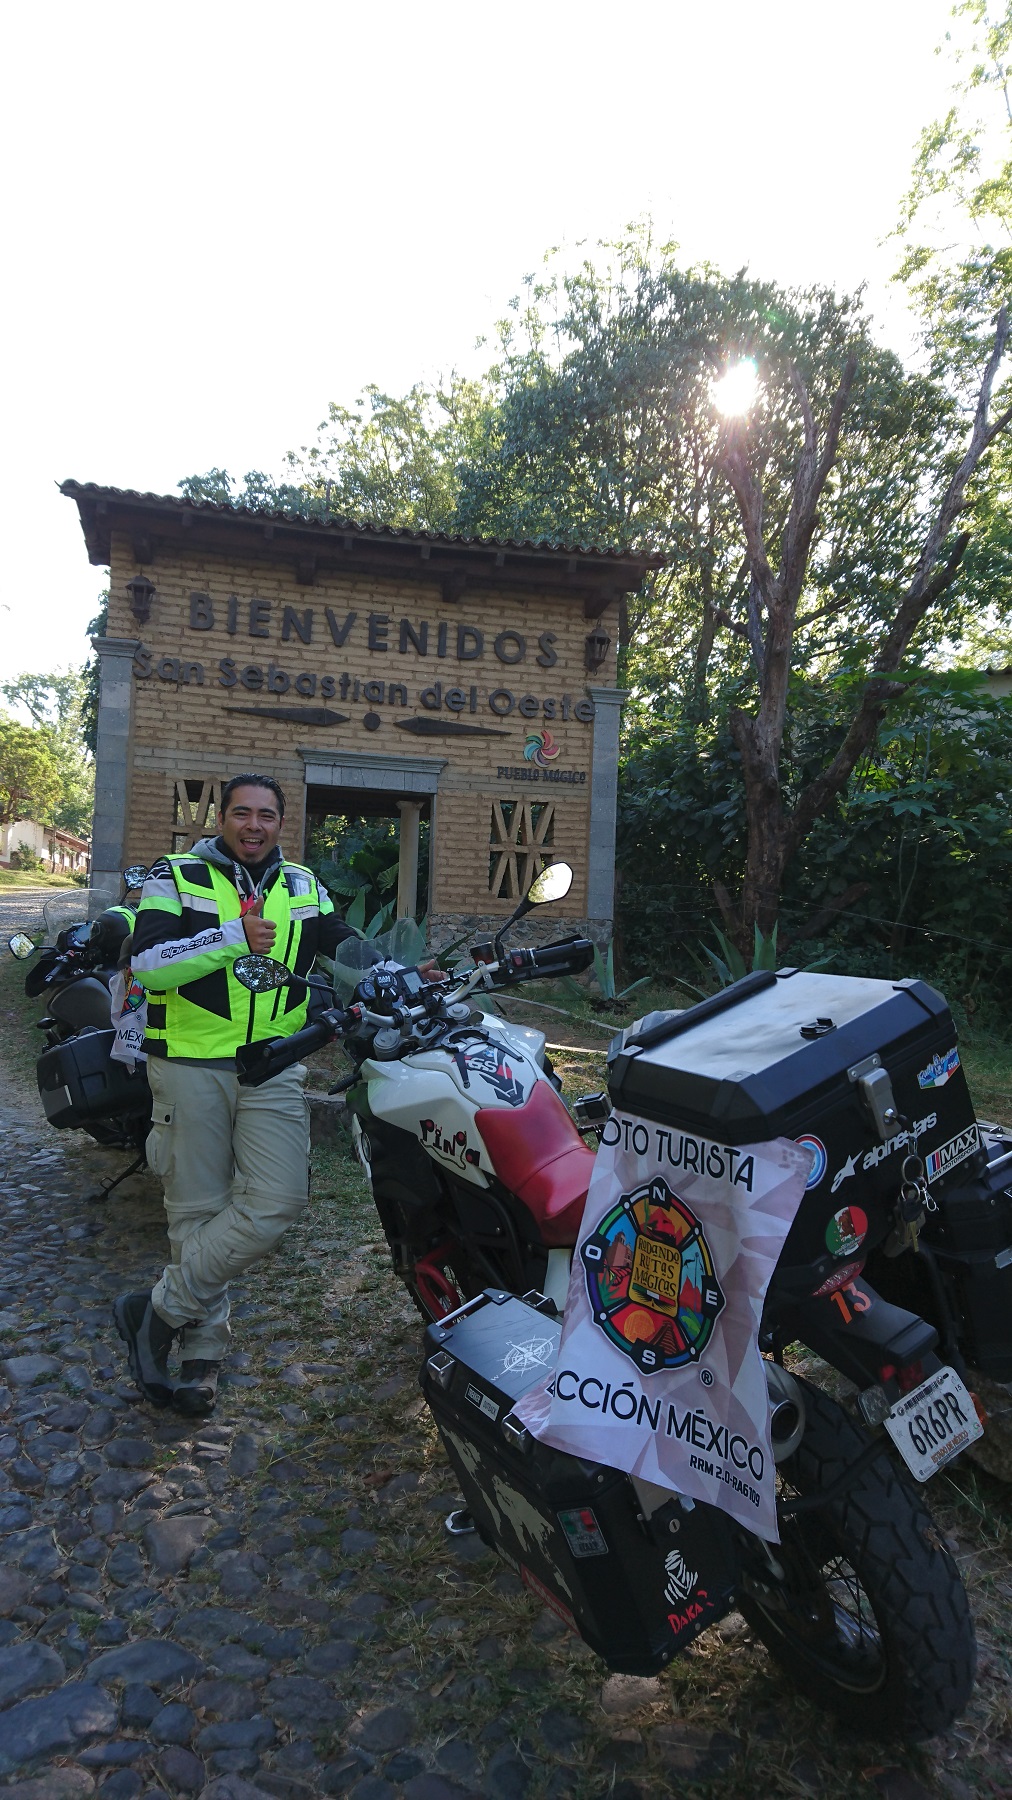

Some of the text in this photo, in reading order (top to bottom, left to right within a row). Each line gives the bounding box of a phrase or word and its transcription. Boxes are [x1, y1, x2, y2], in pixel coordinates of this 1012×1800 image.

[189, 592, 558, 668] BIENVENIDOS
[133, 649, 596, 723] San Sebastian del Oeste
[468, 1057, 498, 1074] GS
[656, 1129, 754, 1192] TURISTA
[940, 1128, 976, 1165] MAX
[942, 1144, 978, 1170] MOTORSPORT
[652, 1186, 666, 1201] N
[585, 1244, 601, 1260] O
[706, 1289, 718, 1306] E
[830, 1281, 871, 1324] 13
[641, 1349, 656, 1366] S
[666, 1405, 765, 1481] MÉXICO
[908, 1392, 968, 1455] 6R6PR
[690, 1454, 760, 1508] RRM 2.0-RA6109
